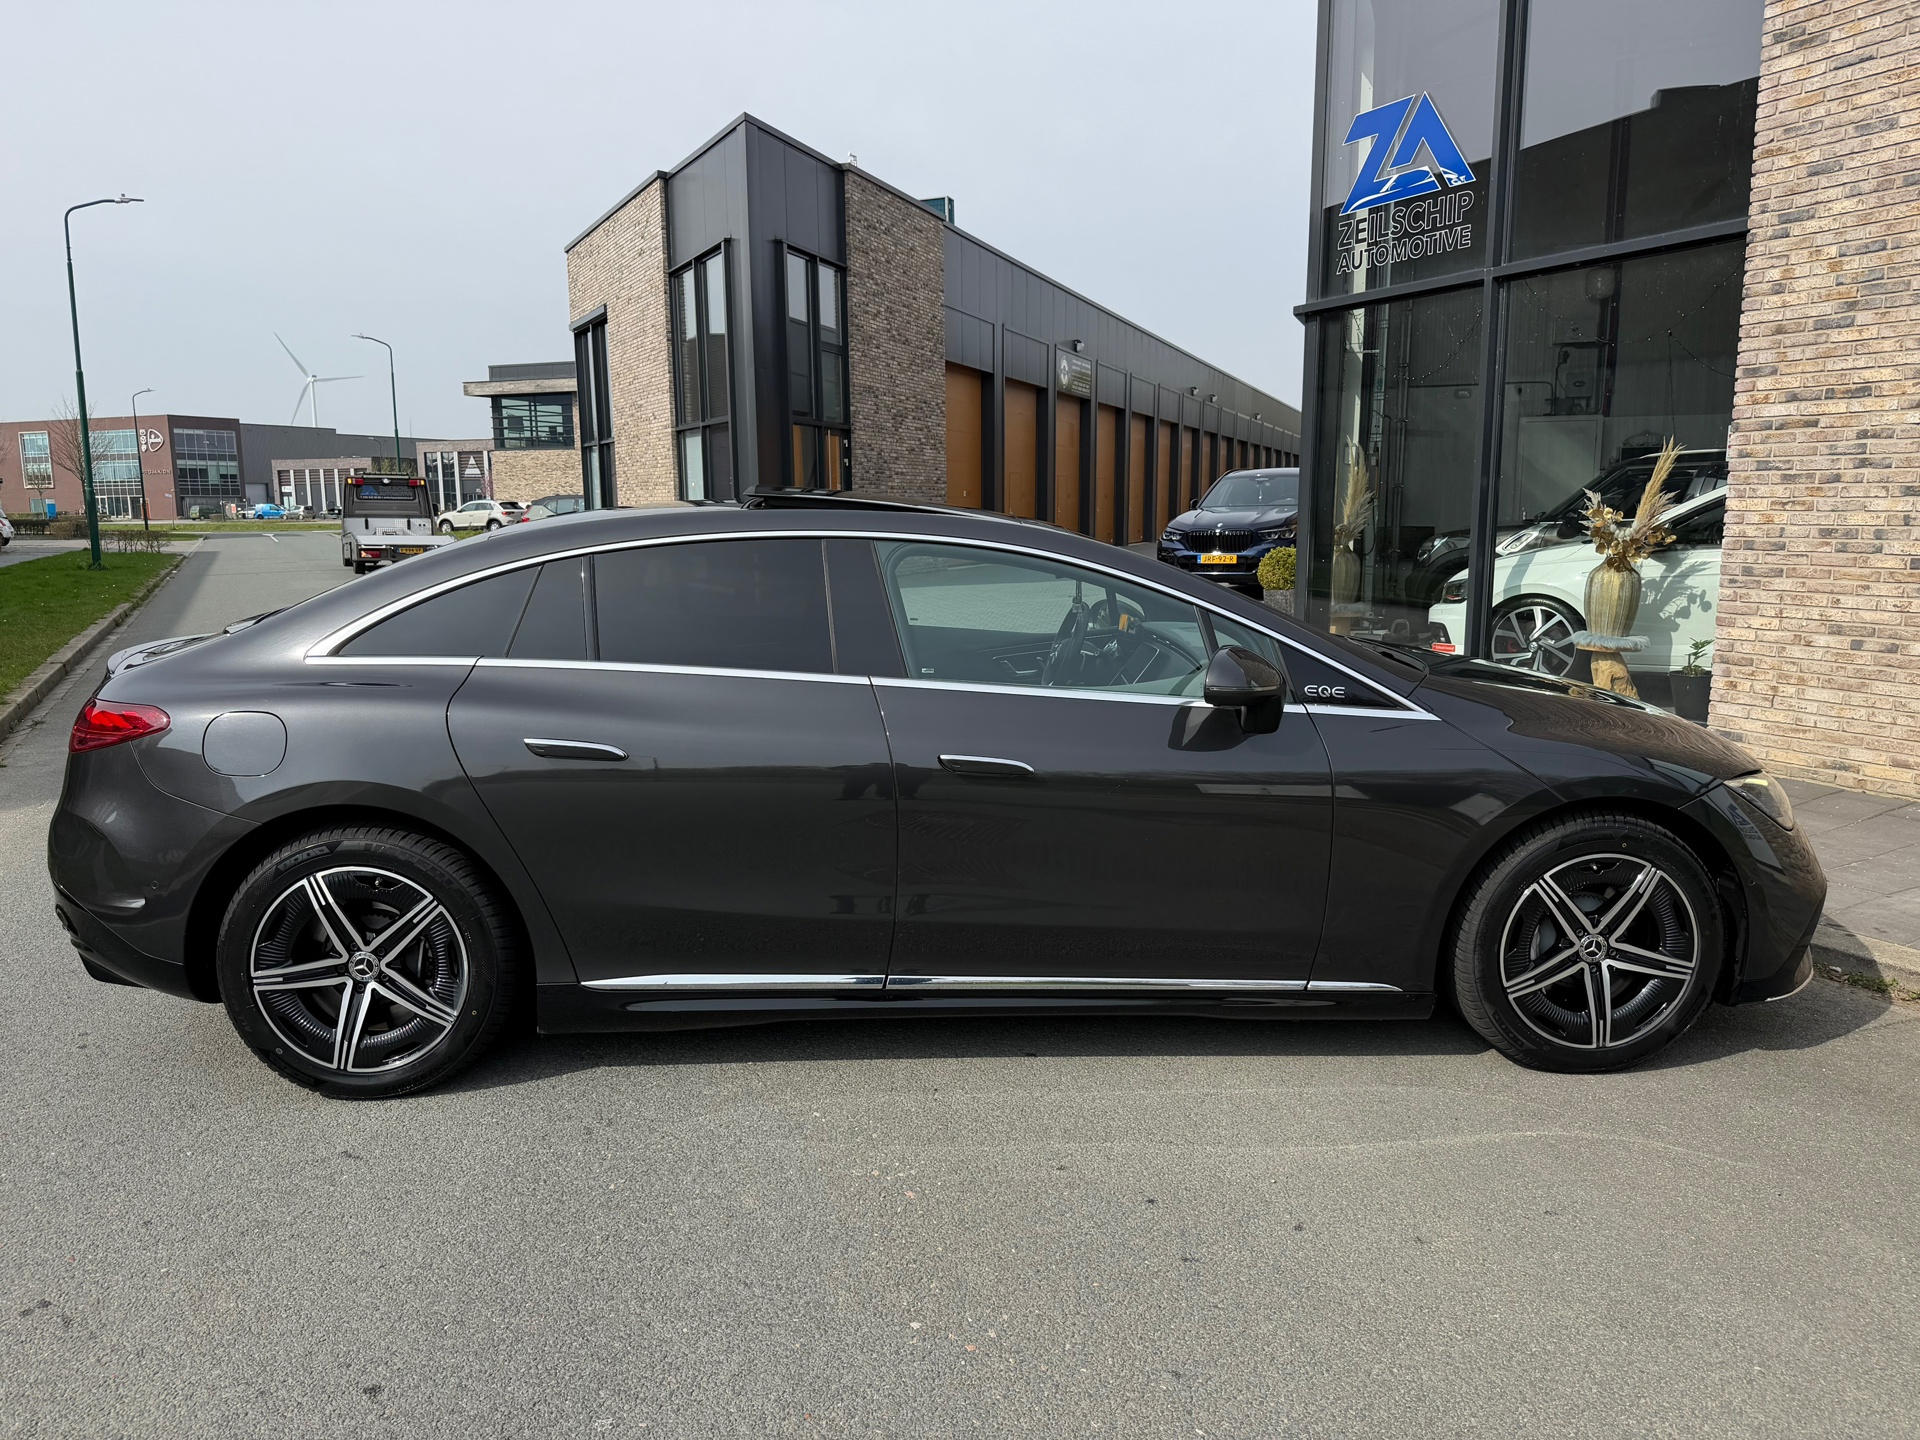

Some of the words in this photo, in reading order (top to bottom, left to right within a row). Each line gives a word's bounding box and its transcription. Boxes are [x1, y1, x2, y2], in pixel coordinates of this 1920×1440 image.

[1339, 91, 1476, 216] ZA
[1337, 190, 1474, 249] ZEILSCHIP
[1336, 224, 1472, 275] AUTOMOTIVE
[1203, 555, 1234, 563] JRF-92-R
[1304, 685, 1345, 698] EQE
